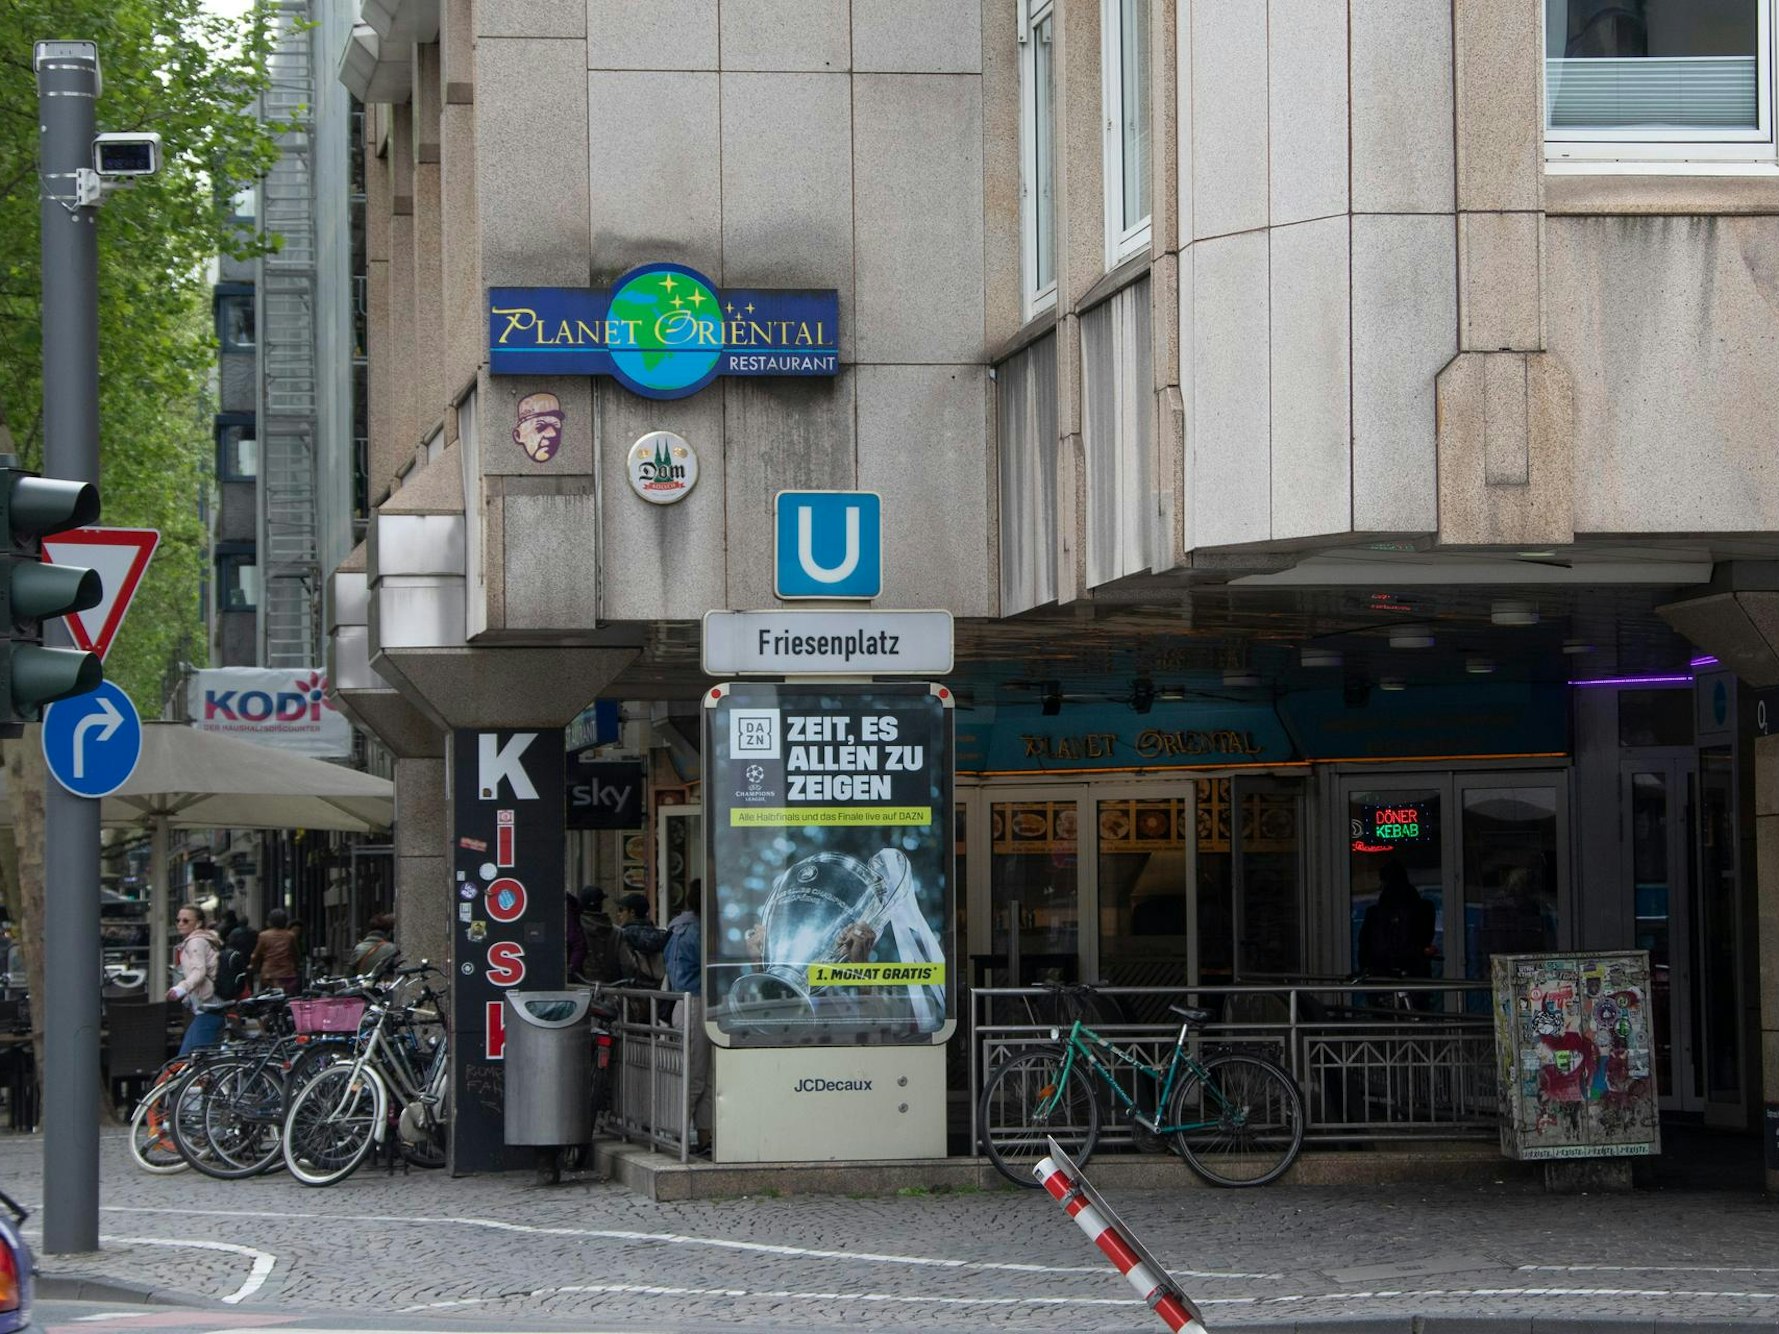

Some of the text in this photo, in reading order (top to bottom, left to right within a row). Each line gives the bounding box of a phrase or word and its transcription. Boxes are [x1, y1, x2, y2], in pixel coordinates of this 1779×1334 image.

[492, 306, 642, 345] PLANET
[729, 356, 836, 371] RESTAURANT
[639, 461, 686, 481] Dom
[798, 507, 860, 584] U
[759, 629, 900, 662] Friesenplatz
[787, 715, 898, 744] ZEIT, ES
[787, 746, 924, 771] ALLEN ZU
[572, 777, 632, 813] sky
[787, 775, 892, 801] ZEIGEN
[738, 812, 924, 822] Alle Halbfinals und das Finale live auf DAZN
[1375, 808, 1419, 825] DÖNER
[1376, 824, 1420, 838] KEBAB
[816, 969, 828, 980] 1.
[831, 968, 879, 980] MONAT
[794, 1079, 872, 1092] JCDecaux
